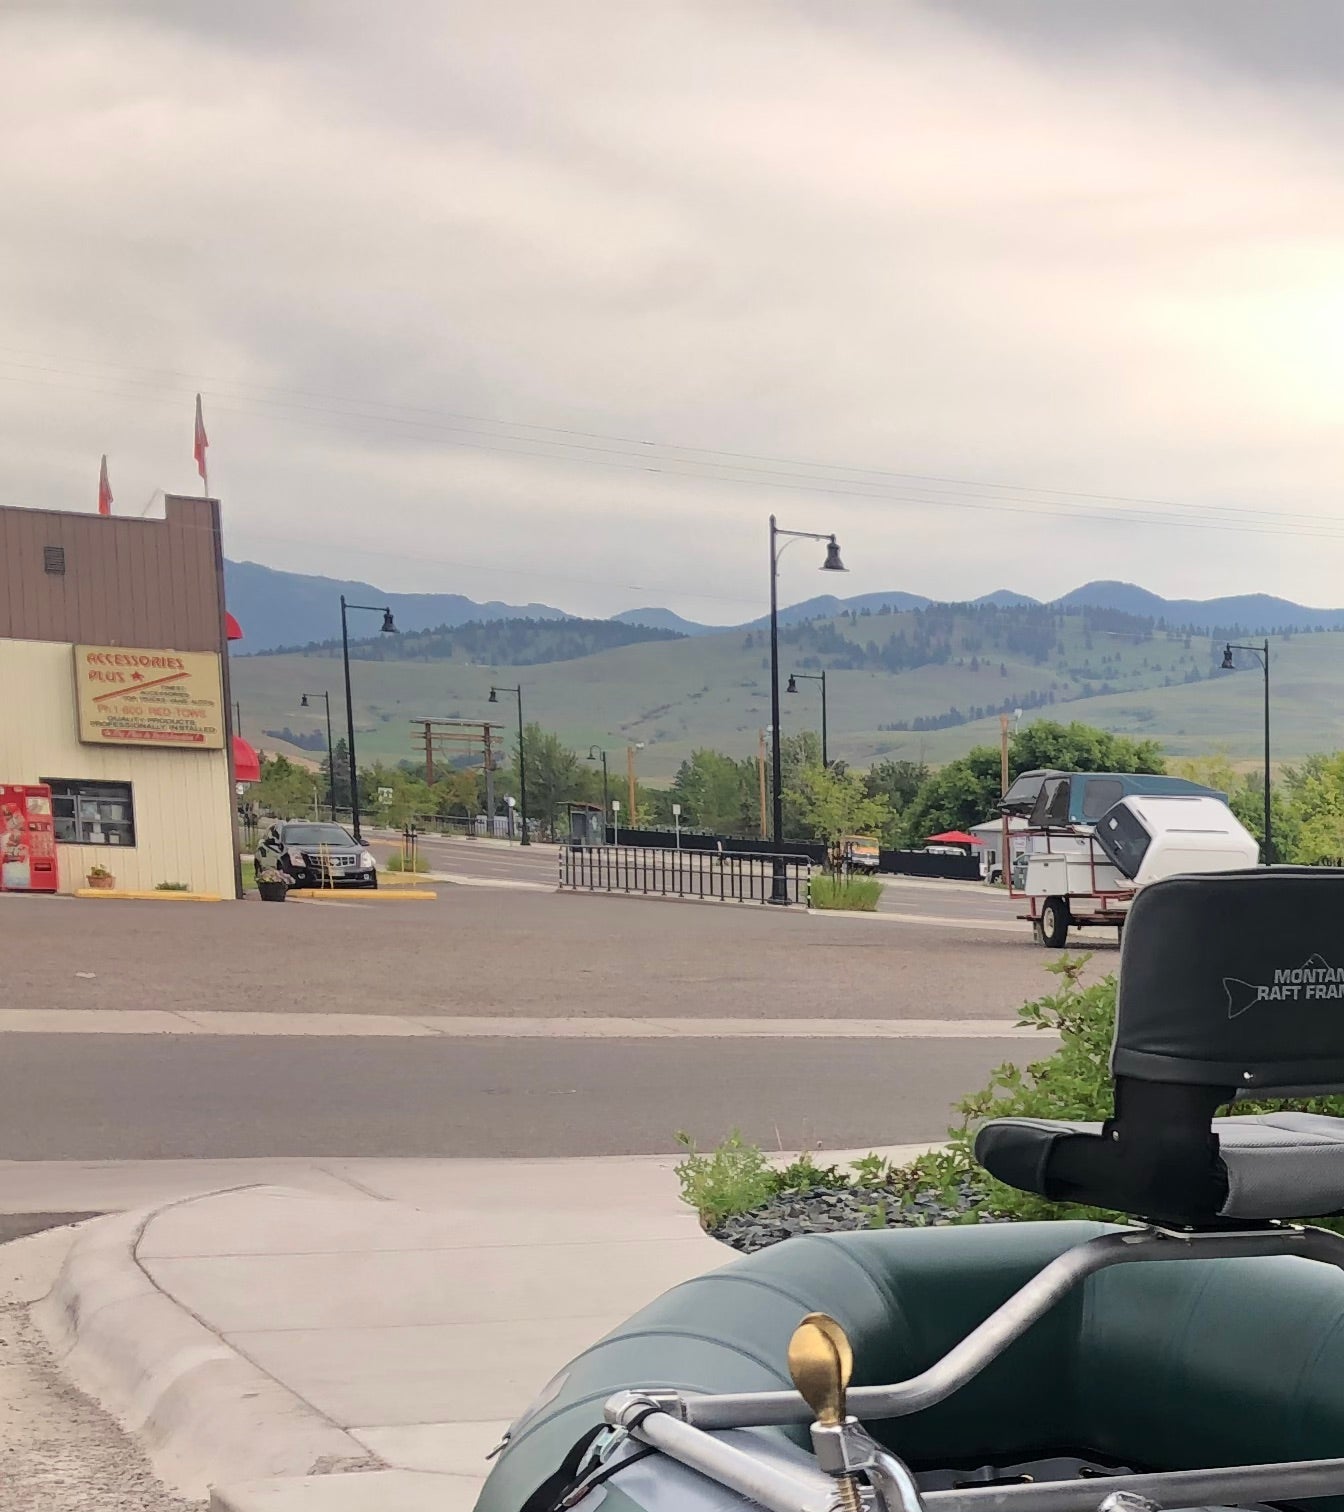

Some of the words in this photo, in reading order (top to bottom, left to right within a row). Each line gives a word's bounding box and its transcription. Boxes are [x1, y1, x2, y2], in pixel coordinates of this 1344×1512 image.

[86, 653, 185, 669] ACCESSORIES
[88, 670, 125, 683] PLUS
[148, 706, 171, 717] RED
[90, 720, 166, 730] PROFESSIONALLY
[1257, 985, 1302, 1001] RAFT
